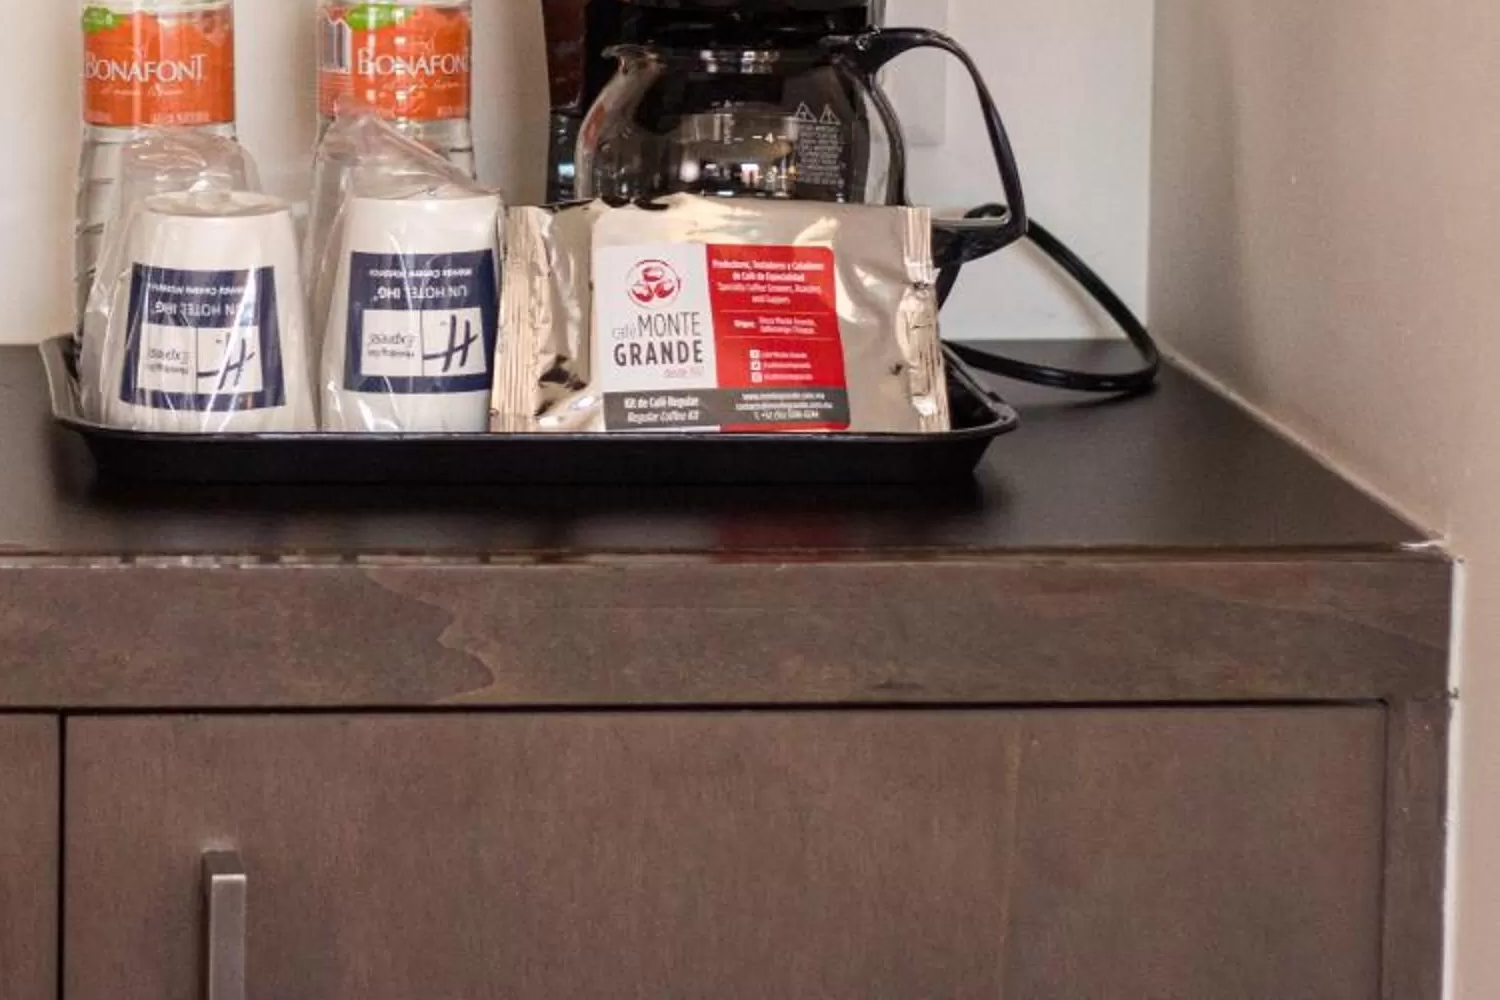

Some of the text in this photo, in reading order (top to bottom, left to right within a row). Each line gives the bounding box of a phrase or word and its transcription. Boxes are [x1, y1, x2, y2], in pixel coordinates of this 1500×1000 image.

[83, 52, 207, 83] BONAFONT
[357, 48, 469, 77] BONAFON
[638, 311, 701, 337] MONTE
[613, 339, 703, 367] GRANDE
